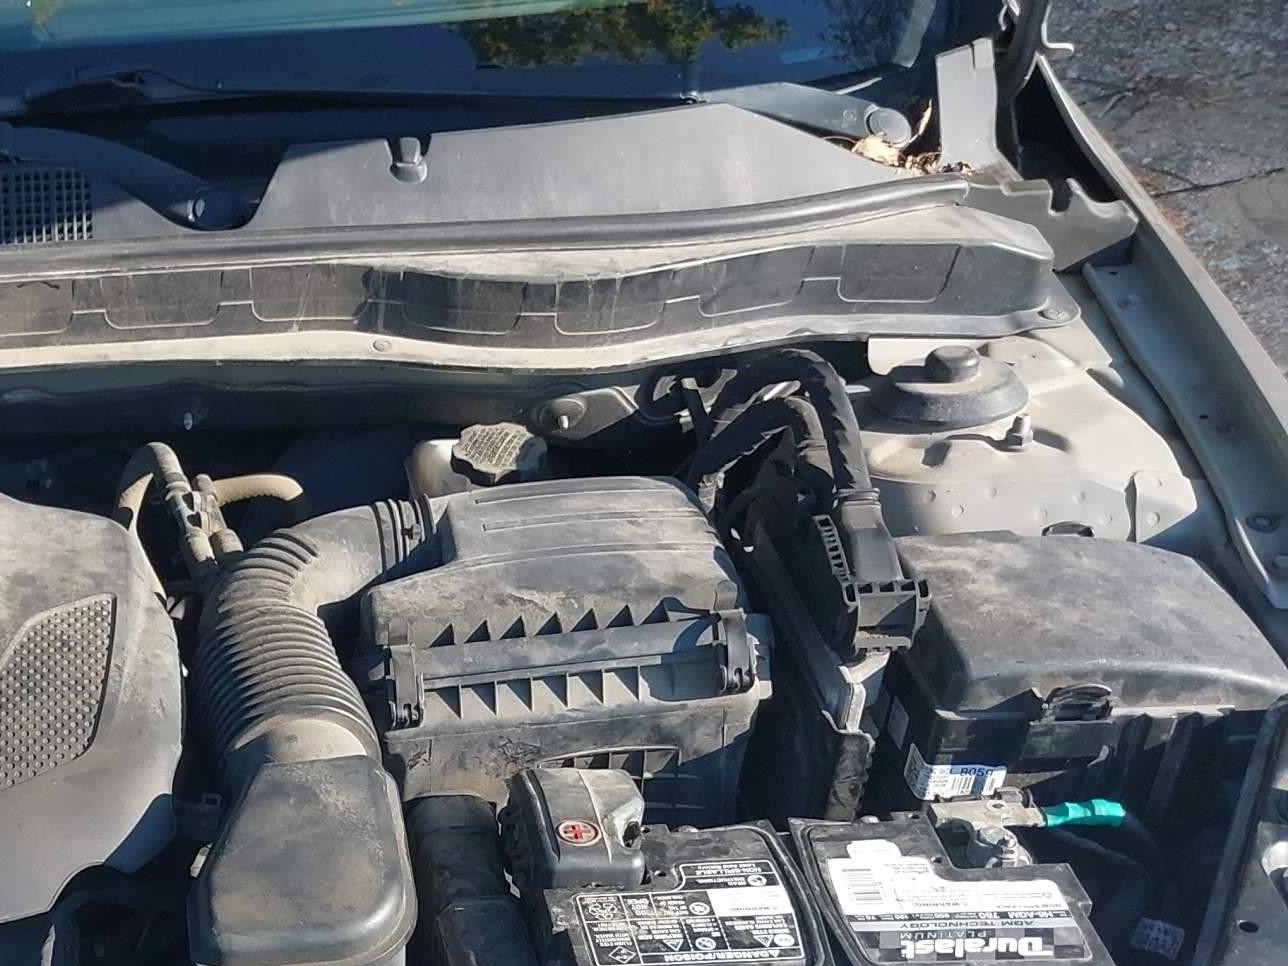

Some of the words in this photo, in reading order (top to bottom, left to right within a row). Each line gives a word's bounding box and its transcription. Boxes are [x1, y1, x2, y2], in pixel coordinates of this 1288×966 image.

[899, 921, 996, 929] TECHNOLOGY
[1000, 920, 1034, 928] AGM
[899, 931, 987, 939] PLATINUM
[900, 936, 1053, 958] Duralast
[663, 951, 770, 961] DANGER/POISON
